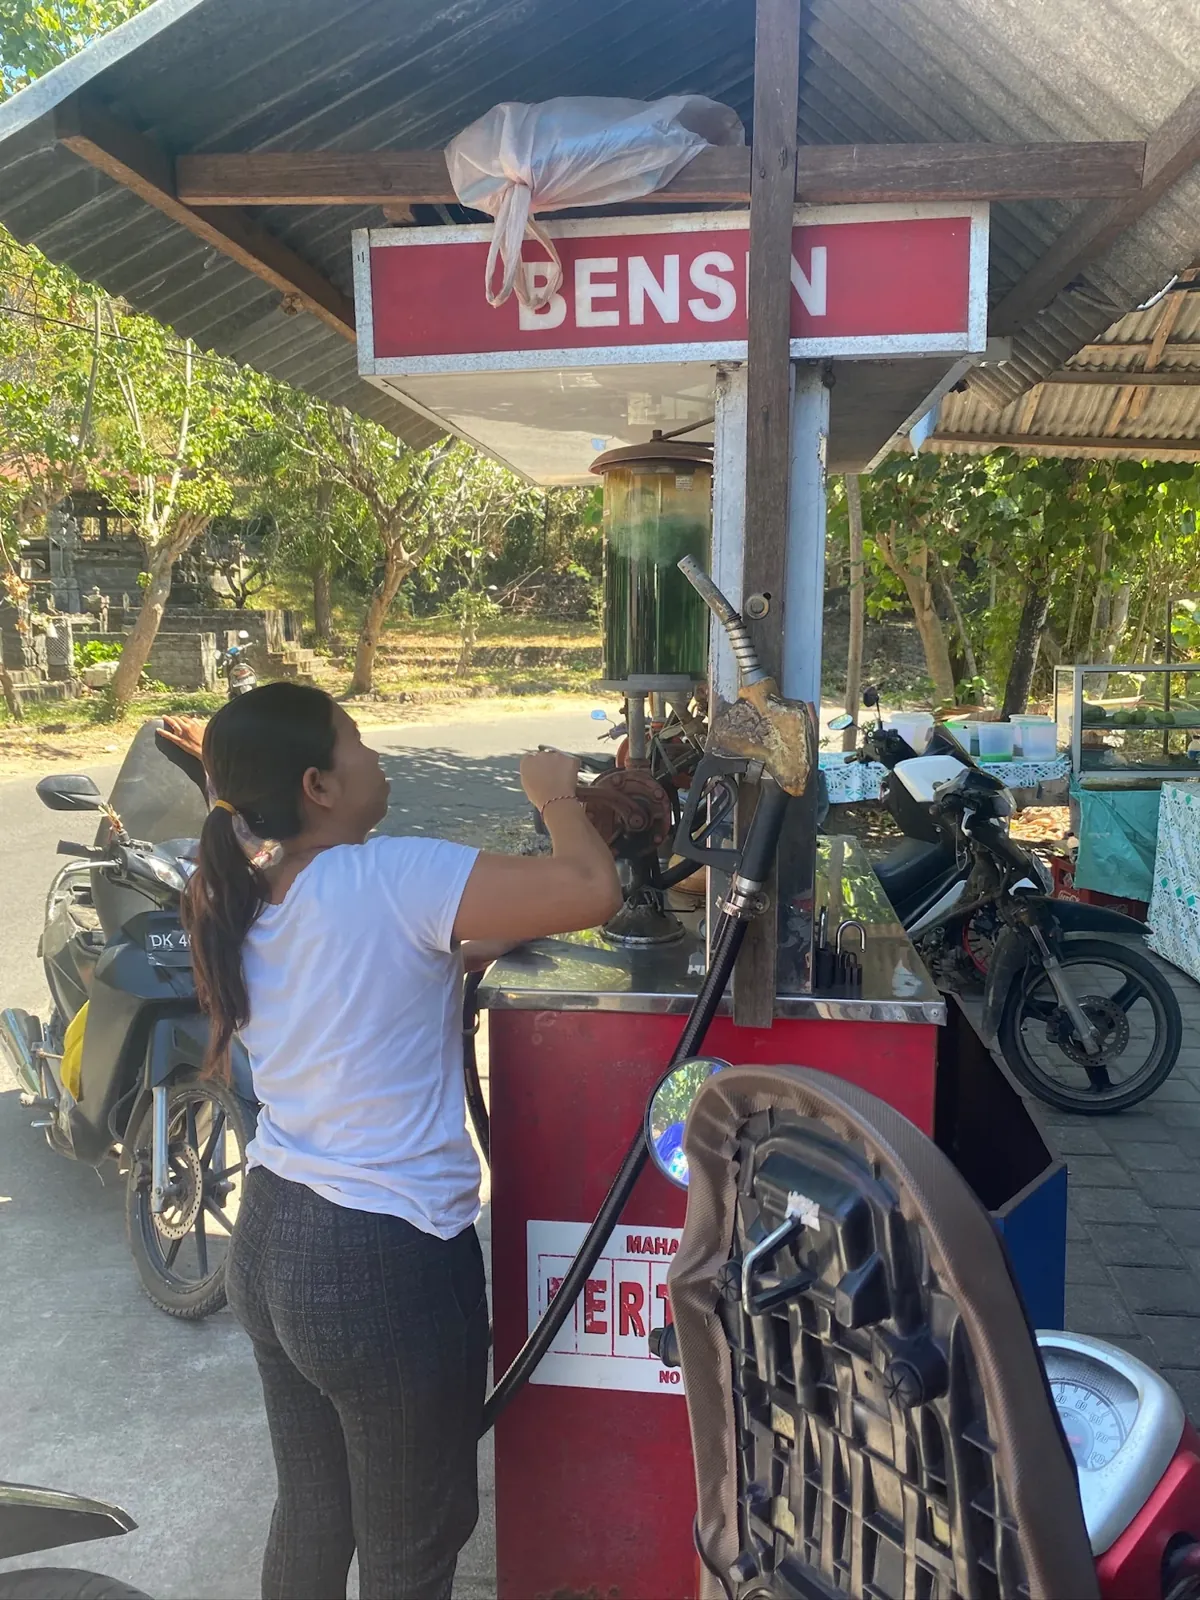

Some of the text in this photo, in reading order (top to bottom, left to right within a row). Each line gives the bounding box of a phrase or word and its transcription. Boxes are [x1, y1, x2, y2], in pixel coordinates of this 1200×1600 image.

[518, 247, 828, 331] BENSN
[149, 934, 174, 948] DK
[659, 1370, 681, 1384] NO
[1095, 1431, 1109, 1444] 120
